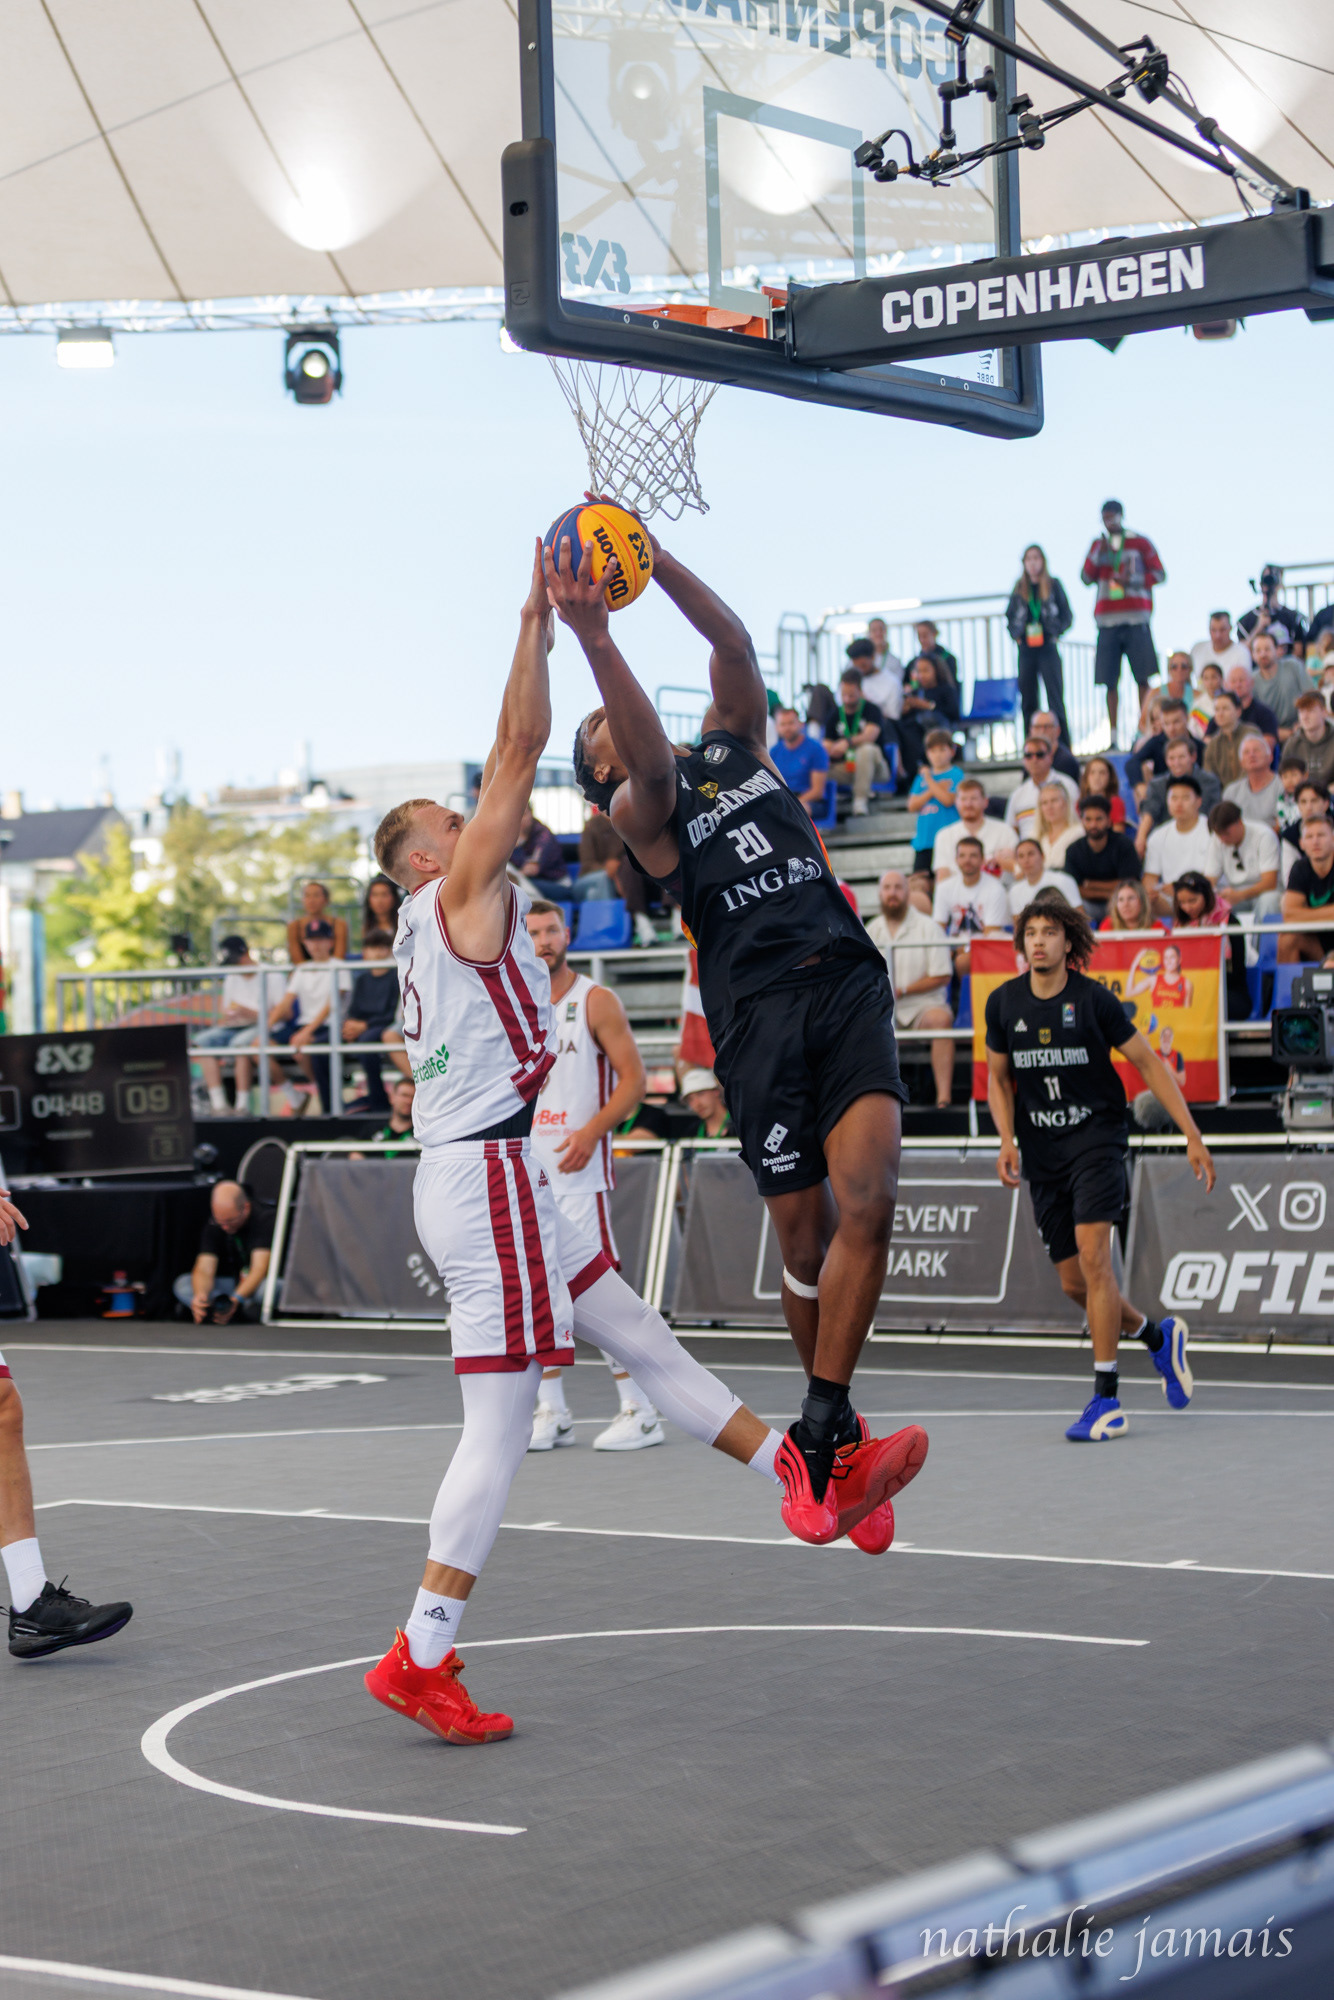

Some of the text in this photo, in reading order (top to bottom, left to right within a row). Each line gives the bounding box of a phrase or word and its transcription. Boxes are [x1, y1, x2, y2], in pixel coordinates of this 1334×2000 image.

[882, 245, 1204, 333] COPENHAGEN
[726, 821, 774, 864] 20
[719, 867, 784, 912] ING
[1012, 1046, 1090, 1069] DEUTSCHLAND
[126, 1083, 169, 1115] 09
[1043, 1075, 1062, 1101] 11
[31, 1090, 105, 1119] 04:48
[1030, 1110, 1067, 1128] ING
[762, 1150, 801, 1167] Domino's
[771, 1162, 796, 1174] Pizza
[892, 1204, 979, 1233] EVENT
[407, 1253, 440, 1296] CITY
